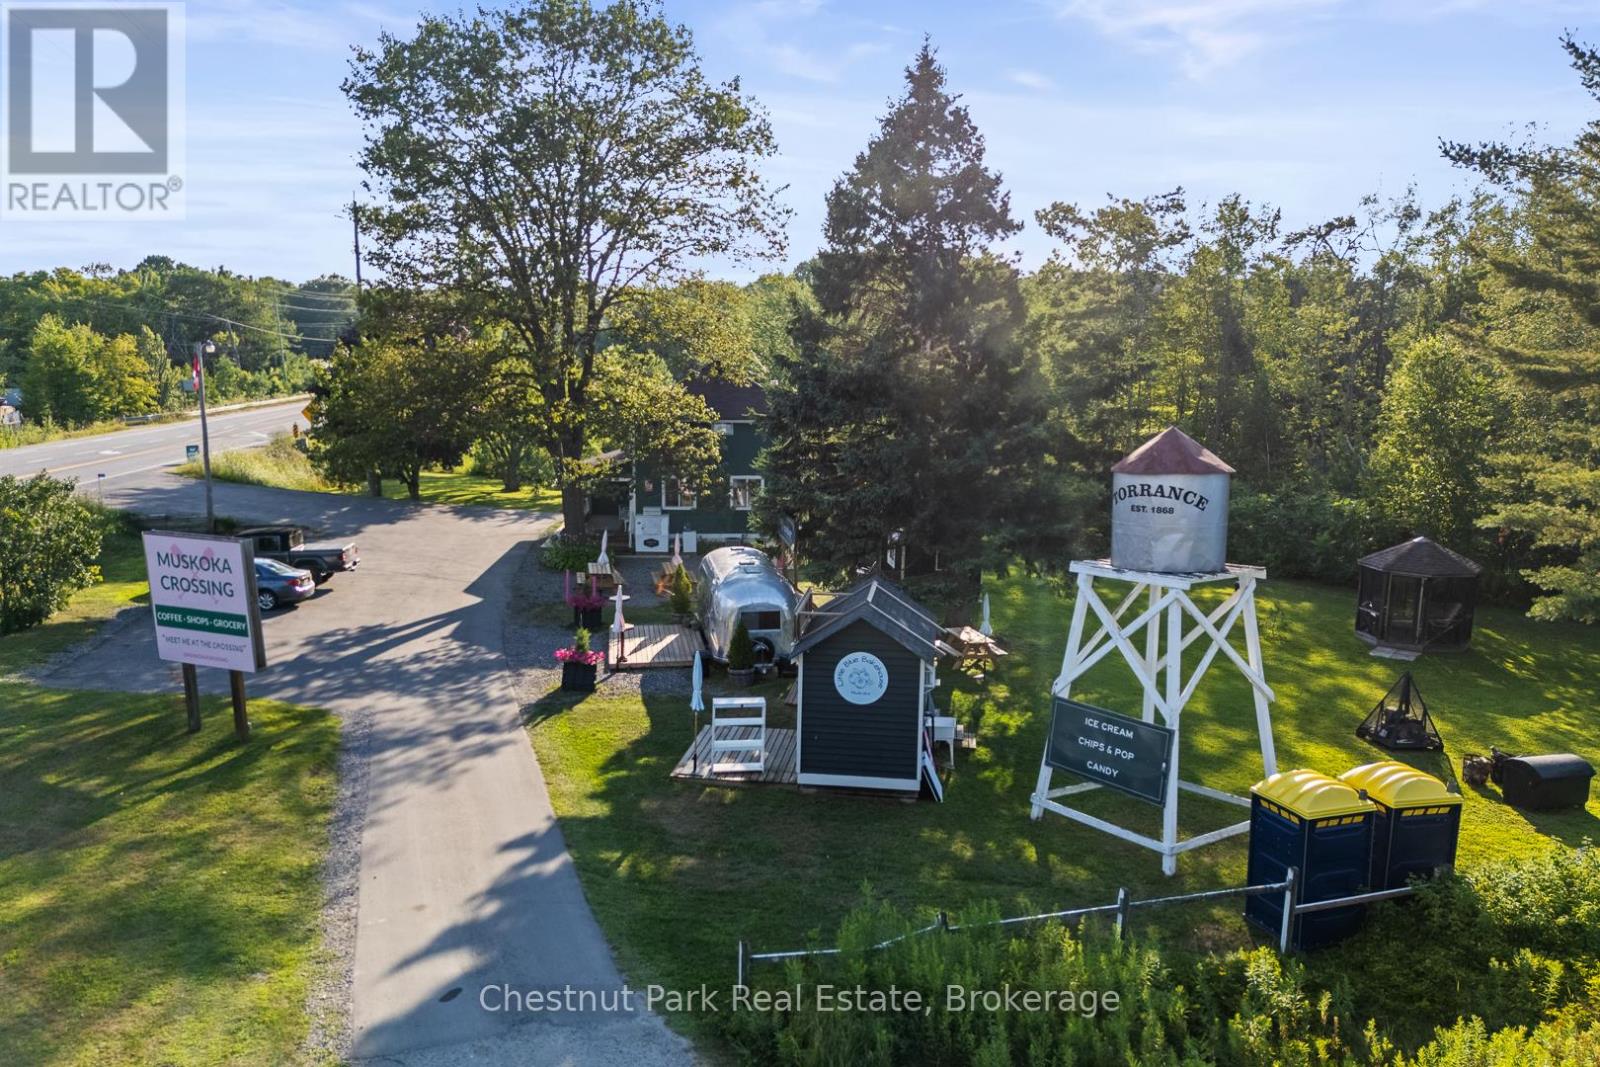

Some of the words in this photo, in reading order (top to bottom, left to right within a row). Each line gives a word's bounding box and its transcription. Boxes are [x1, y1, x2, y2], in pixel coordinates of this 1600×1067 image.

[1130, 504, 1148, 513] EST.
[1151, 506, 1175, 515] 1868
[156, 551, 233, 574] MUSKOKA
[160, 575, 235, 598] CROSSING
[157, 611, 183, 623] COFFEE
[186, 615, 209, 626] SHOPS
[213, 618, 247, 631] GROCERY
[191, 638, 199, 646] AT
[200, 640, 212, 649] THE
[1084, 717, 1099, 729] ICE
[1101, 722, 1134, 739] CREAM
[1078, 736, 1105, 752] CHIPS
[1106, 746, 1112, 755] &
[1114, 748, 1135, 761] POP
[1086, 760, 1119, 778] CANDY
